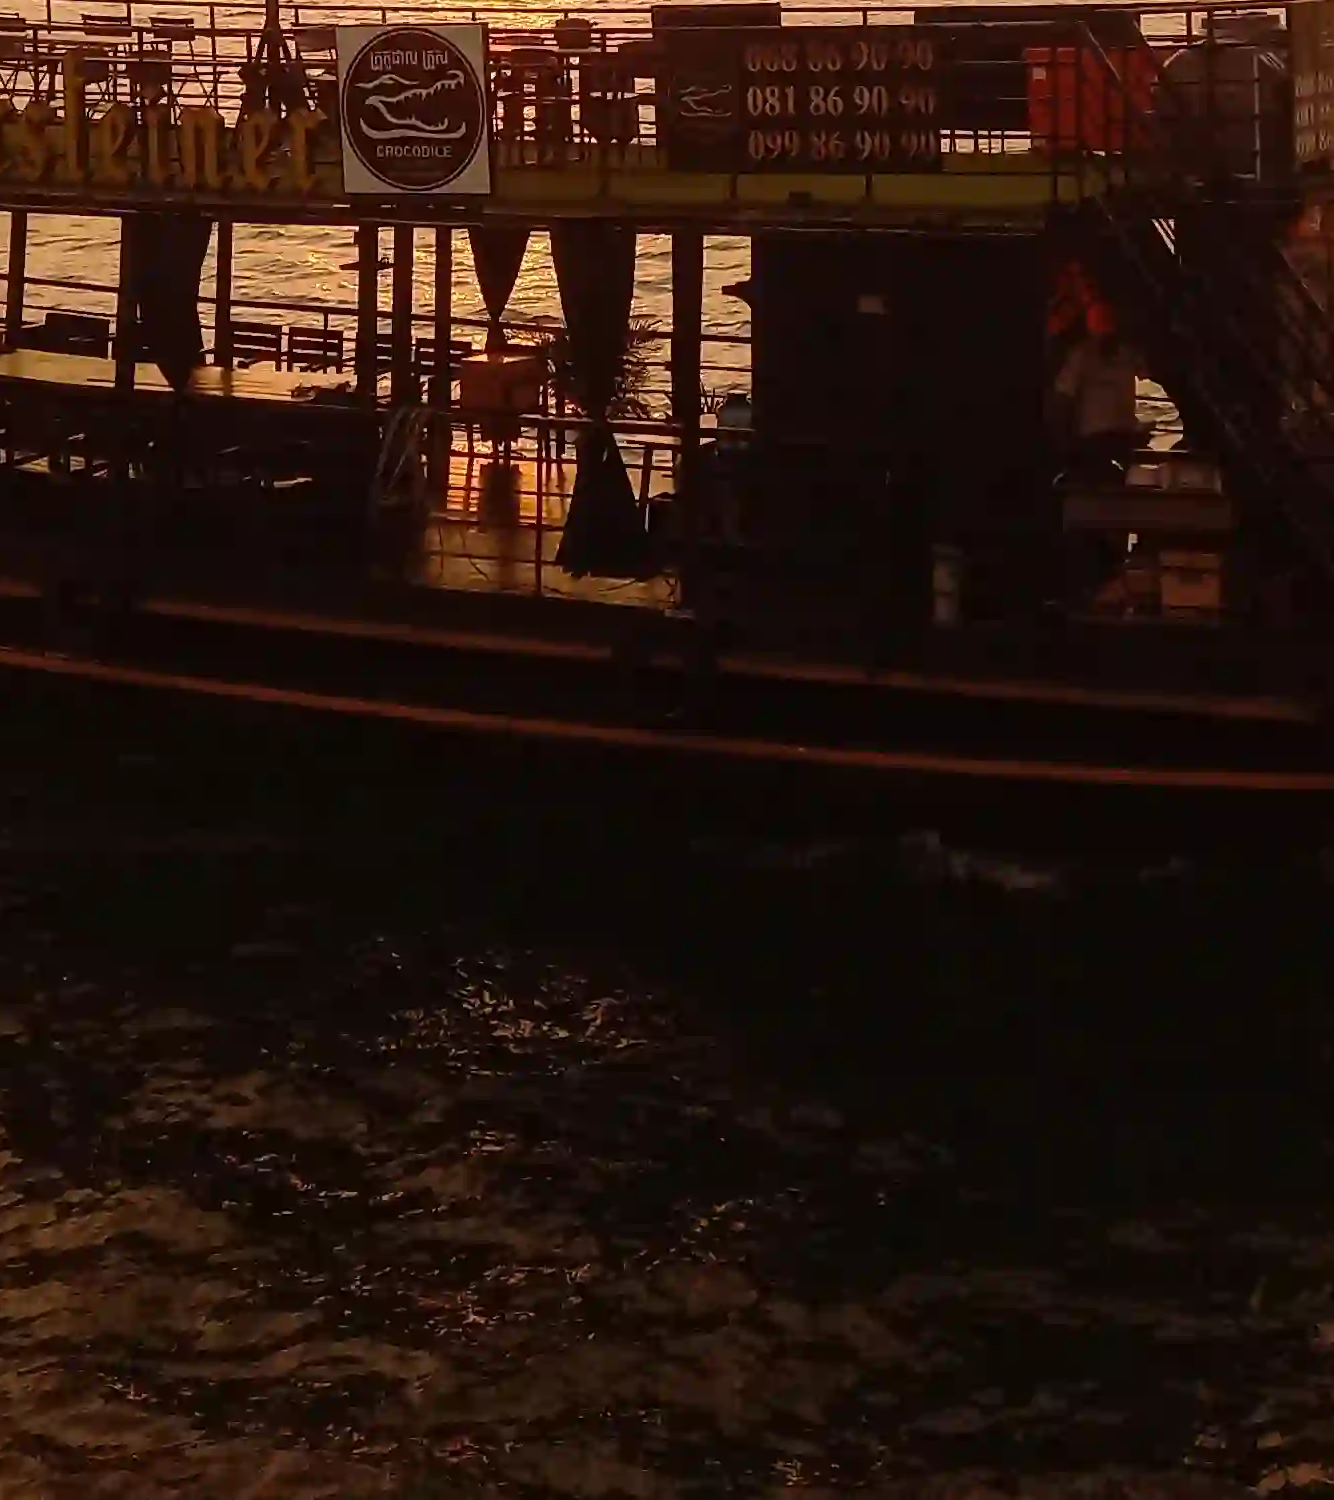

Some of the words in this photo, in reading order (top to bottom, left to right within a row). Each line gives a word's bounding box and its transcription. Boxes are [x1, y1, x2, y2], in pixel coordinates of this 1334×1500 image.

[852, 41, 888, 72] 90
[899, 40, 935, 71] 90
[746, 86, 797, 117] 081
[809, 86, 844, 117] 86
[853, 86, 889, 117] 90
[376, 145, 453, 158] CROCODILE
[748, 129, 800, 161] 099
[809, 129, 846, 161] 86
[854, 129, 891, 161] 90
[900, 129, 937, 161] 90
